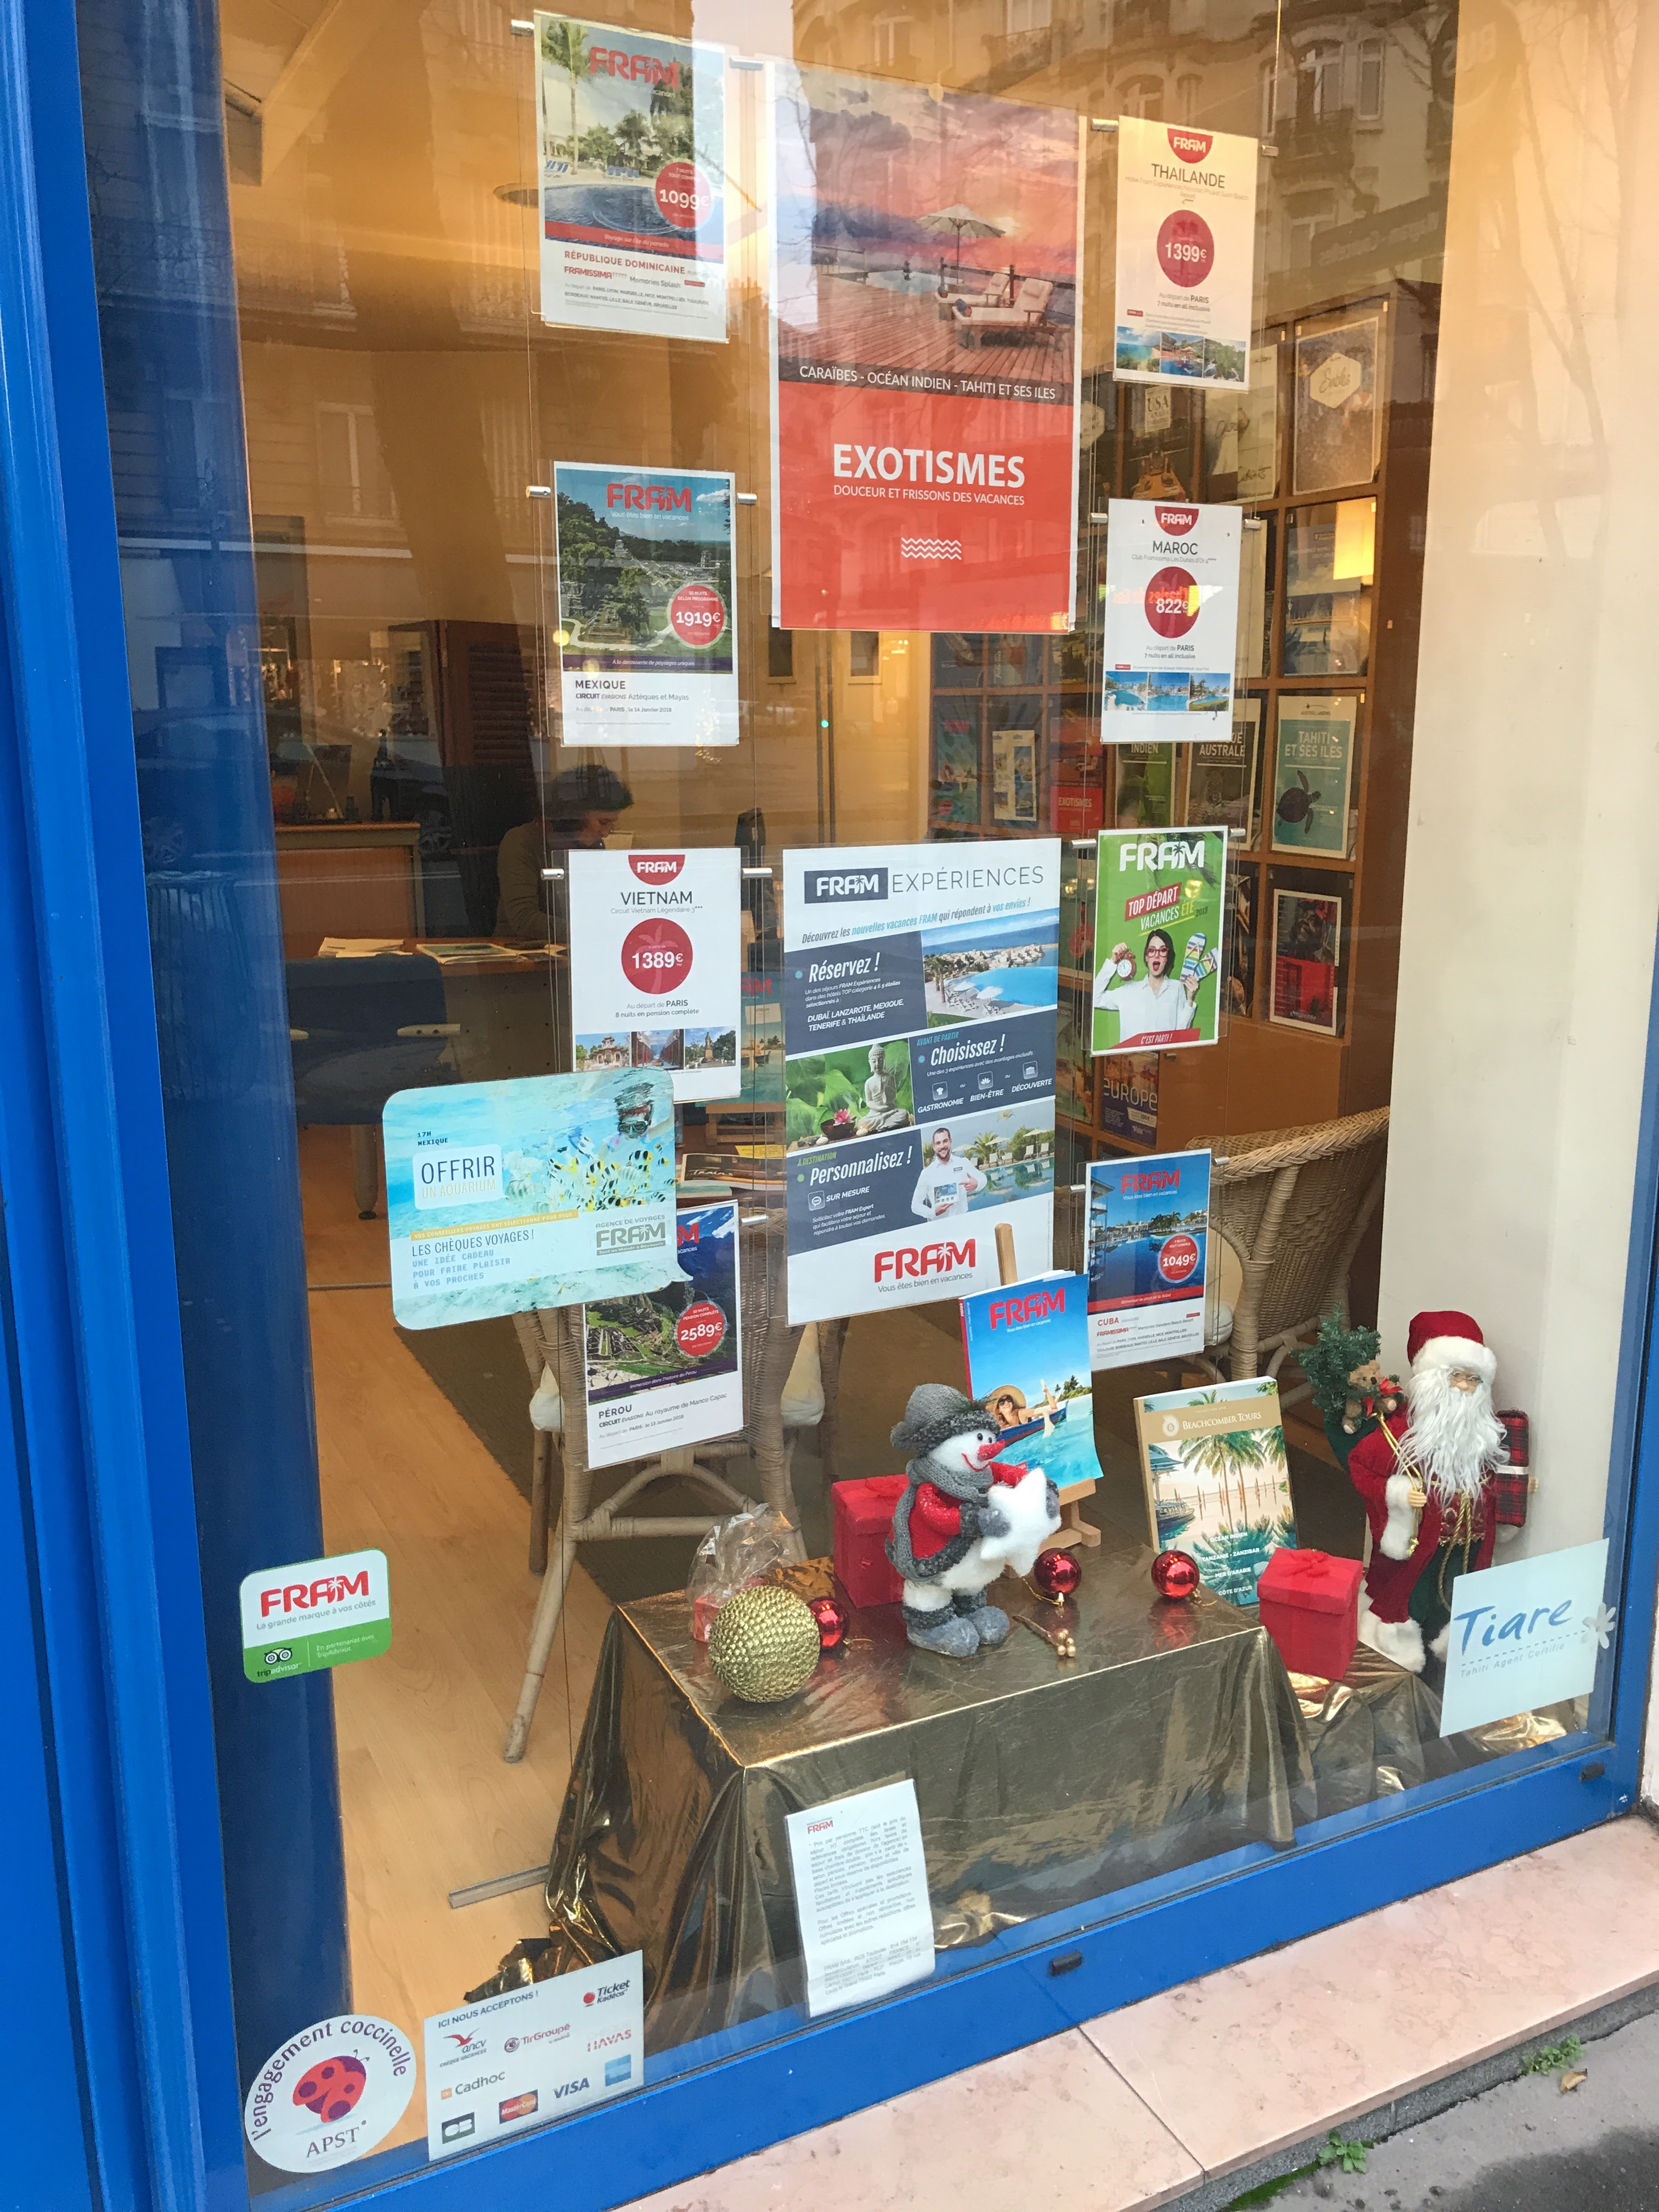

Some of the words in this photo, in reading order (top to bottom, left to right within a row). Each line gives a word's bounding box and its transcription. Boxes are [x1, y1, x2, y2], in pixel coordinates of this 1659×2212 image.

[590, 46, 679, 89] FRAM
[1173, 137, 1206, 153] FRAM
[1152, 163, 1225, 188] THAILANDE
[565, 250, 622, 266] RÉPUBLIQUE
[625, 259, 685, 274] DOMINICAINE
[1165, 242, 1206, 263] 1399€
[564, 266, 612, 279] FRAMISSIMA
[630, 276, 659, 286] Memories
[661, 280, 680, 288] Splash
[1190, 295, 1209, 303] PARIS
[799, 366, 857, 382] CARAÏBES
[868, 372, 908, 387] OCÉAN
[911, 376, 951, 390] INDIEN
[960, 380, 996, 394] TAHITI
[999, 383, 1012, 395] ET
[1014, 385, 1032, 397] SES
[1035, 386, 1056, 399] ILES
[834, 444, 1025, 488] EXOTISMES
[607, 483, 692, 512] FRAM
[834, 484, 885, 498] DOUCEUR
[889, 488, 900, 498] ET
[903, 488, 951, 501] FRISSONS
[953, 492, 972, 503] DES
[974, 492, 1025, 505] VACANCES
[1161, 514, 1192, 526] FRAM
[1153, 540, 1198, 555] MAROC
[676, 611, 721, 627] 1919€
[575, 680, 625, 690] MEXIQUE
[1131, 743, 1158, 753] INDIEN
[1299, 731, 1329, 744] TAHITI
[1199, 744, 1245, 757] AUSTRALE
[1285, 744, 1296, 756] ET
[1299, 745, 1317, 757] SES
[1321, 746, 1342, 758] ILES
[1119, 840, 1205, 872] FRAM
[637, 861, 676, 873] FRAM
[816, 874, 879, 896] FRAM
[893, 866, 1043, 893] EXPÉRIENCES
[620, 891, 692, 905] VIETNAM
[1128, 899, 1144, 917] TOP
[1147, 886, 1178, 911] DÉPART
[802, 929, 839, 944] Découvrez
[840, 928, 850, 937] les
[851, 922, 885, 935] nouvelles
[887, 918, 917, 929] vacances
[919, 913, 938, 924] FRAM
[939, 912, 950, 923] qui
[951, 905, 986, 918] répondent
[987, 904, 991, 913] à
[993, 904, 1003, 912] vos
[1005, 899, 1026, 910] envies
[1141, 906, 1180, 931] VACANCES
[1181, 899, 1194, 916] ÉTÉ
[633, 951, 683, 969] 1389€
[809, 956, 872, 983] Réservez
[831, 1006, 872, 1018] LANZAROTE,
[873, 999, 904, 1011] MEXIQUE,
[809, 1020, 840, 1032] TENERIFE
[848, 1011, 885, 1024] THAÏLANDE
[917, 1036, 933, 1046] AVANT
[933, 1035, 940, 1043] DE
[941, 1031, 959, 1042] PARTIR
[1141, 1035, 1154, 1044] C'EST
[1155, 1034, 1169, 1042] PARTI
[931, 1038, 997, 1066] Choisissez
[918, 1098, 964, 1113] GASTRONOMIE
[970, 1089, 1004, 1102] BIEN-ÊTRE
[1012, 1078, 1052, 1093] DÉCOUVERTE
[417, 1138, 448, 1147] MEXIQUE
[421, 1155, 495, 1184] OFFRIR
[810, 1151, 904, 1186] Personnalisez
[422, 1187, 437, 1199] UN
[439, 1179, 495, 1197] AQUARIUM
[1121, 1169, 1181, 1194] FRAM
[826, 1193, 840, 1202] SUR
[842, 1186, 870, 1199] MESURE
[596, 1220, 623, 1228] AGENCE
[635, 1214, 665, 1223] VOYAGES
[413, 1244, 431, 1256] LES
[435, 1237, 482, 1253] CHÈQUES
[485, 1230, 529, 1246] VOYAGES
[596, 1222, 665, 1248] FRAM
[413, 1259, 428, 1267] UNE
[435, 1253, 455, 1264] IDÉE
[462, 1250, 494, 1260] CADEAU
[413, 1268, 435, 1278] POUR
[441, 1264, 467, 1274] FAIRE
[473, 1257, 510, 1269] PLAISIR
[874, 1238, 976, 1283] FRAM
[1163, 1252, 1196, 1267] 1049€
[414, 1280, 419, 1289] À
[447, 1273, 484, 1284] PROCHES
[990, 1288, 1065, 1330] FRAM
[681, 1322, 722, 1340] 2589€
[1098, 1317, 1119, 1326] CUBA
[709, 1393, 727, 1401] Capac
[599, 1404, 632, 1419] PÉROU
[1182, 1417, 1237, 1430] BEACHCOMBER
[1237, 1411, 1261, 1422] TOURS
[261, 1570, 369, 1617] FRAM
[268, 1617, 297, 1629] grande
[298, 1610, 330, 1621] marque
[338, 1604, 352, 1613] vos
[354, 1600, 376, 1610] côtés
[1454, 1600, 1573, 1656] Tiare
[257, 1662, 300, 1677] tripadvisor
[598, 1979, 630, 1996] Ticket
[438, 2019, 449, 2028] ICI
[452, 2011, 478, 2024] NOUS
[480, 1991, 533, 2015] ACCEPTONS
[521, 2023, 571, 2045] TirGroupé
[587, 2029, 631, 2052] HAVAS
[252, 2022, 332, 2141] l'engagement
[341, 2021, 411, 2076] coccinelle
[455, 2071, 506, 2095] Cadhoc
[554, 2078, 590, 2099] VISA
[307, 2126, 360, 2158] APST
